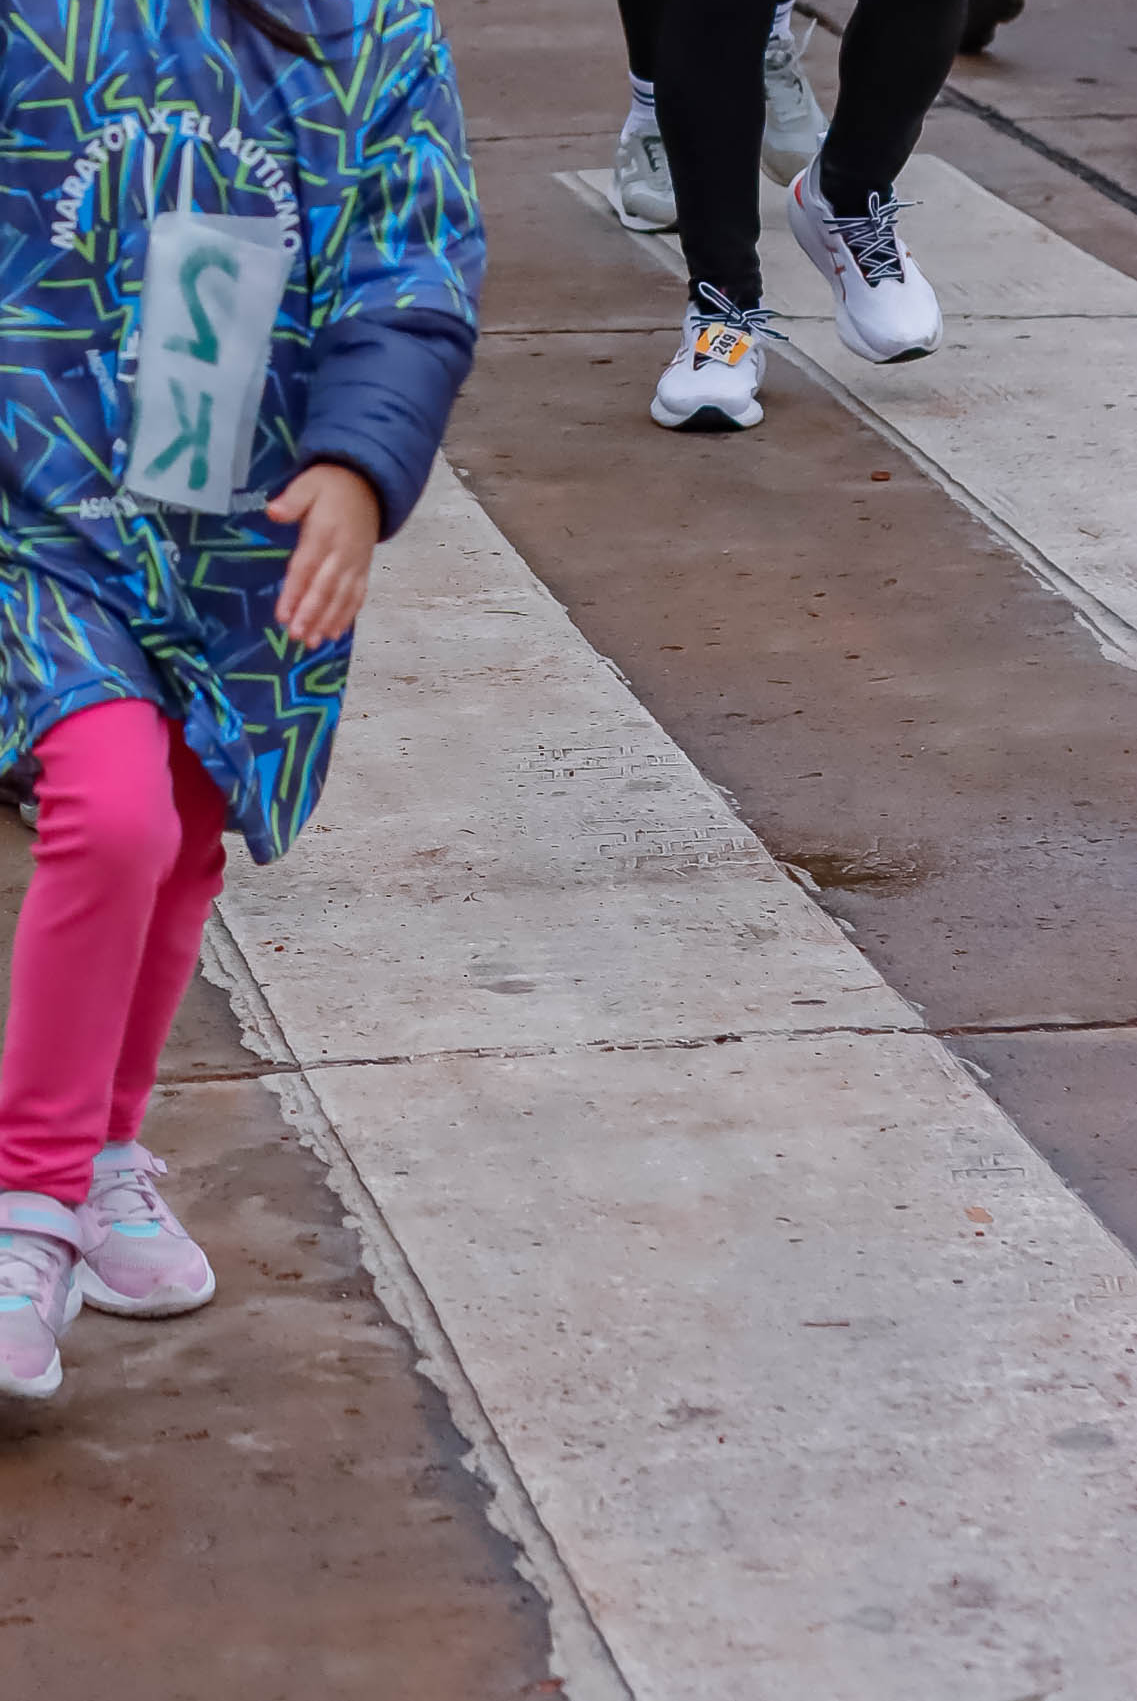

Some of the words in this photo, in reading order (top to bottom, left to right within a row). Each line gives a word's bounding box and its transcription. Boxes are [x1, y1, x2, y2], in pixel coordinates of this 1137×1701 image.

[148, 107, 171, 134] X
[179, 109, 213, 143] EL
[218, 126, 302, 254] AUTISMO
[712, 333, 738, 356] 249
